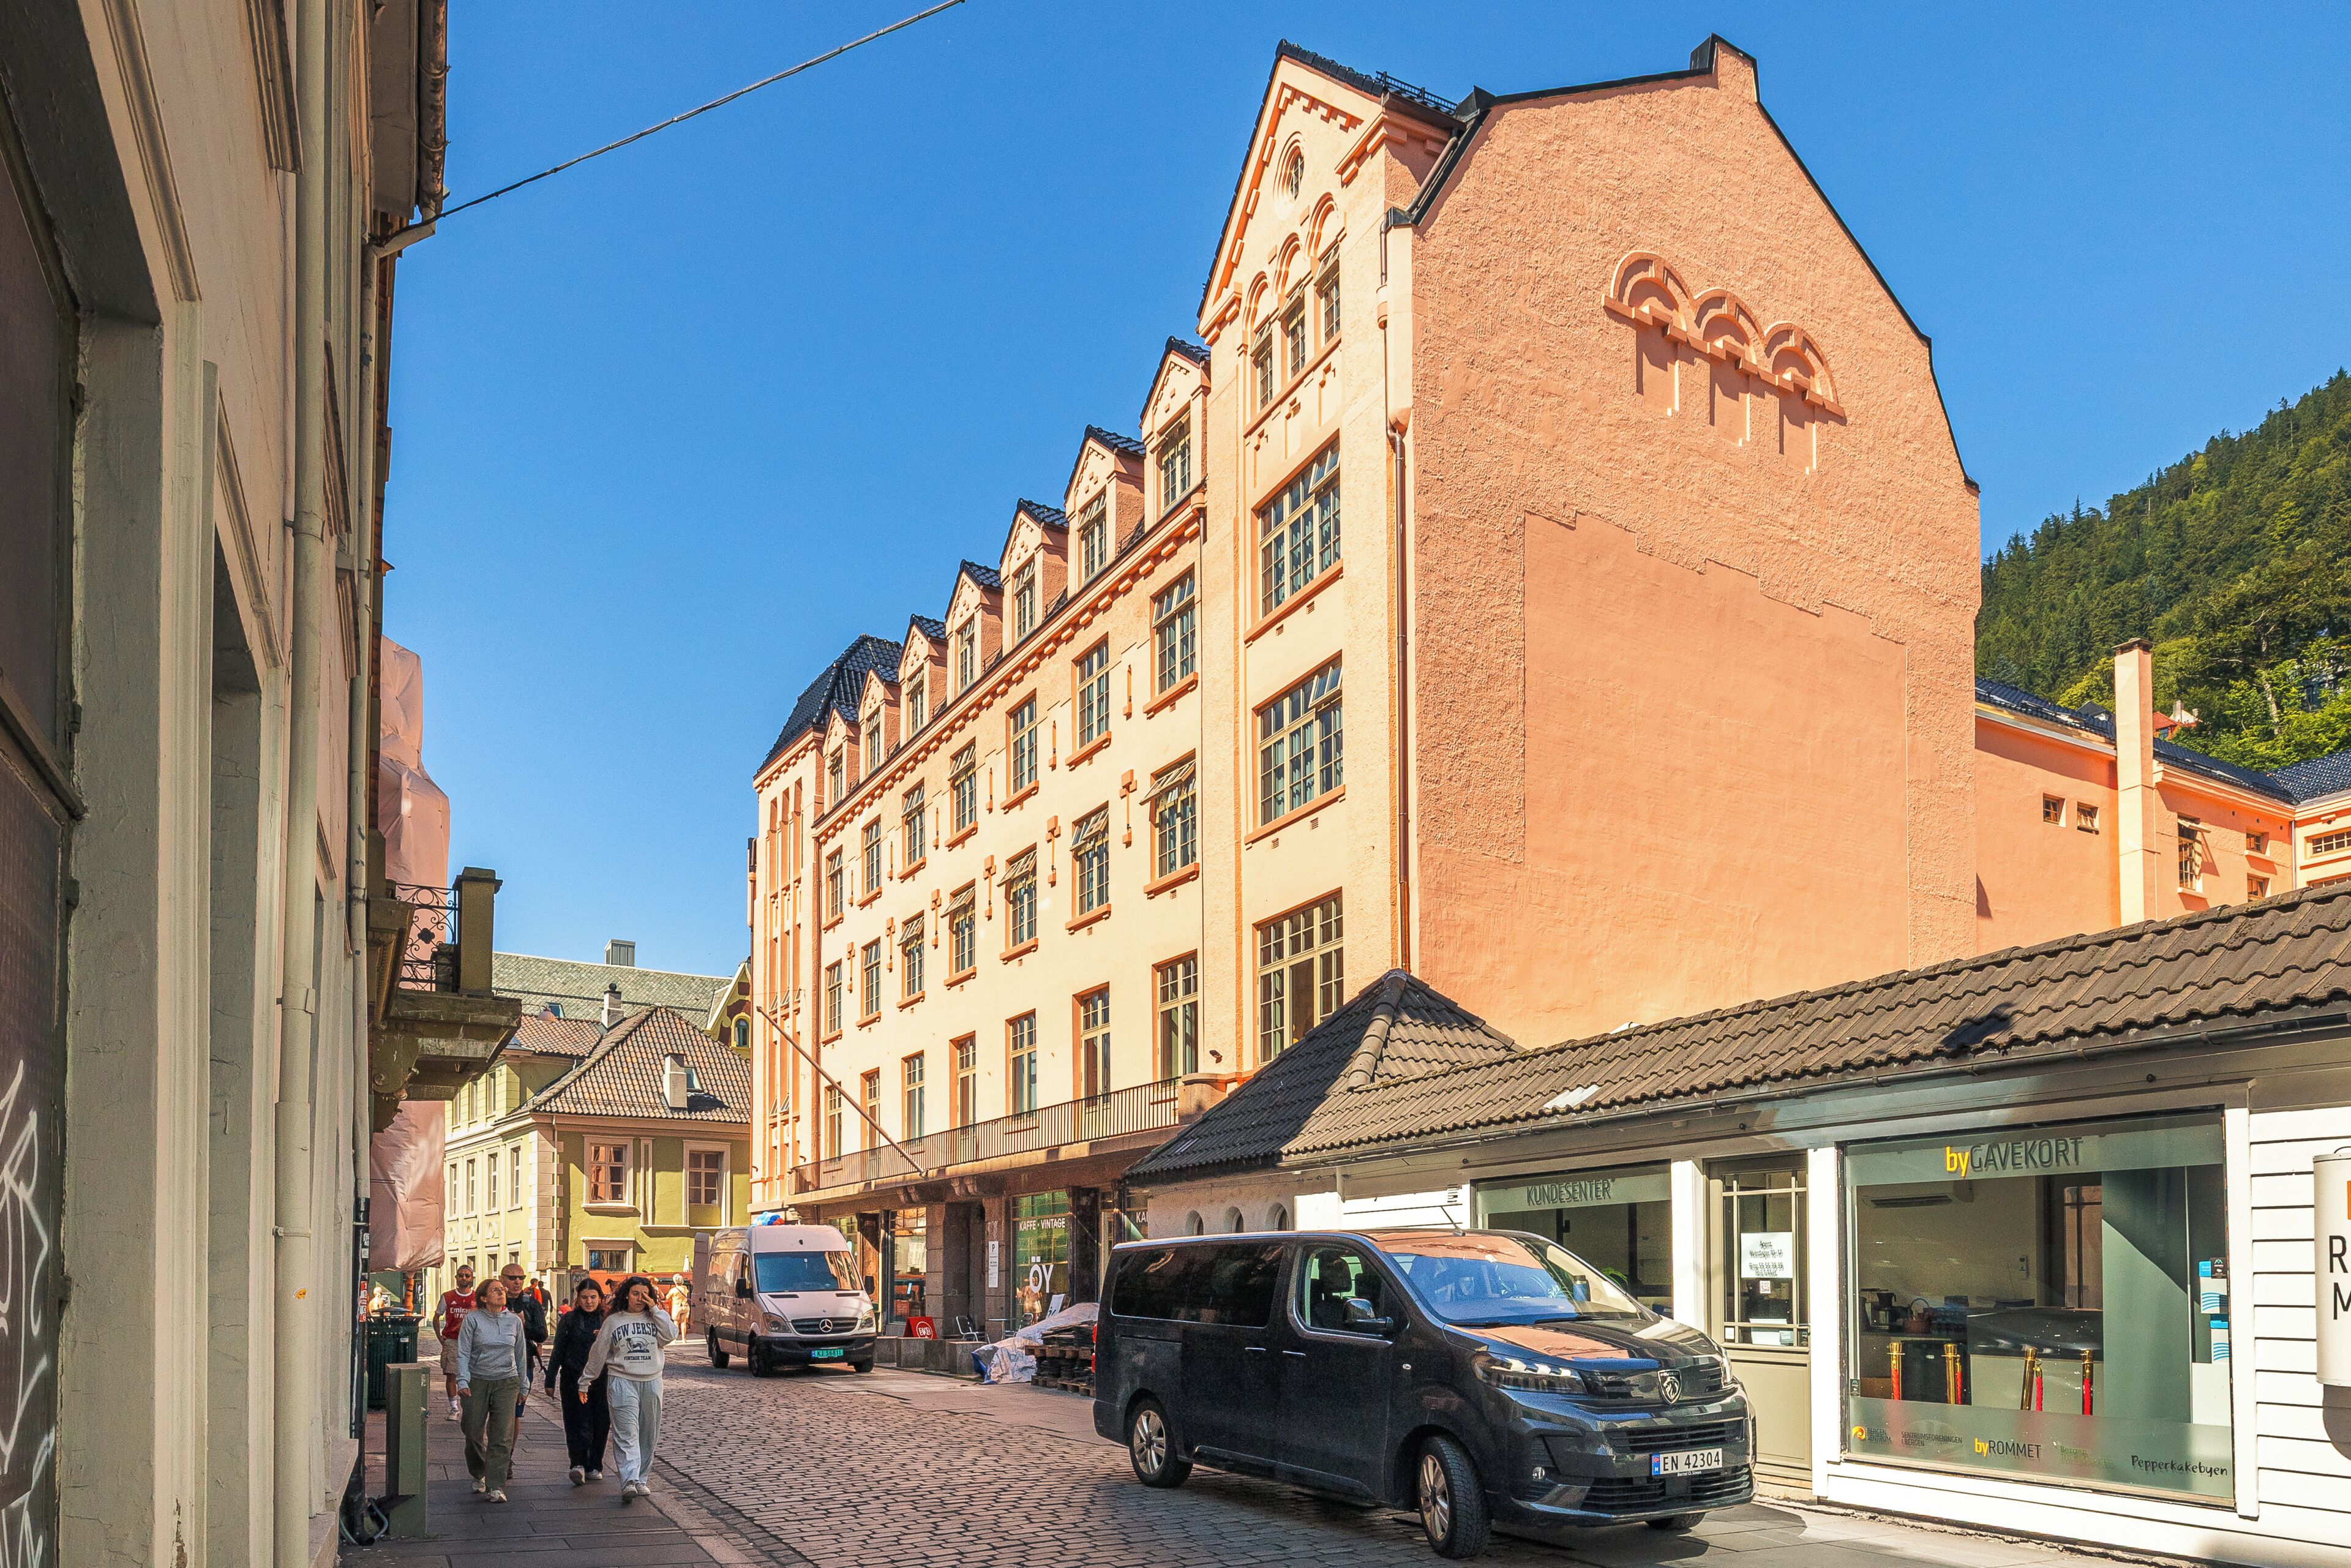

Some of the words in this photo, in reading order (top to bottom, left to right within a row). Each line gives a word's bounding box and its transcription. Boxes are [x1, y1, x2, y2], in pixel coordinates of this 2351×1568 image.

[1945, 1136, 2083, 1177] byGAVEKORT
[1526, 1179, 1611, 1206] KUNDESENTER
[1019, 1220, 1036, 1231] KAFFE
[1041, 1218, 1065, 1229] VINTAGE
[1136, 1211, 1148, 1223] KA
[1029, 1256, 1054, 1293] ÖY
[612, 1323, 630, 1346] NEW
[632, 1322, 658, 1338] JERSE
[1867, 1434, 1891, 1442] SENTRUM
[1901, 1431, 1962, 1444] SENTRUMSFORENINGEN
[1974, 1437, 2042, 1459] byROMMET
[1663, 1455, 1679, 1471] EN
[1684, 1451, 1720, 1469] 42304
[2131, 1455, 2228, 1477] Pepperkakebyen
